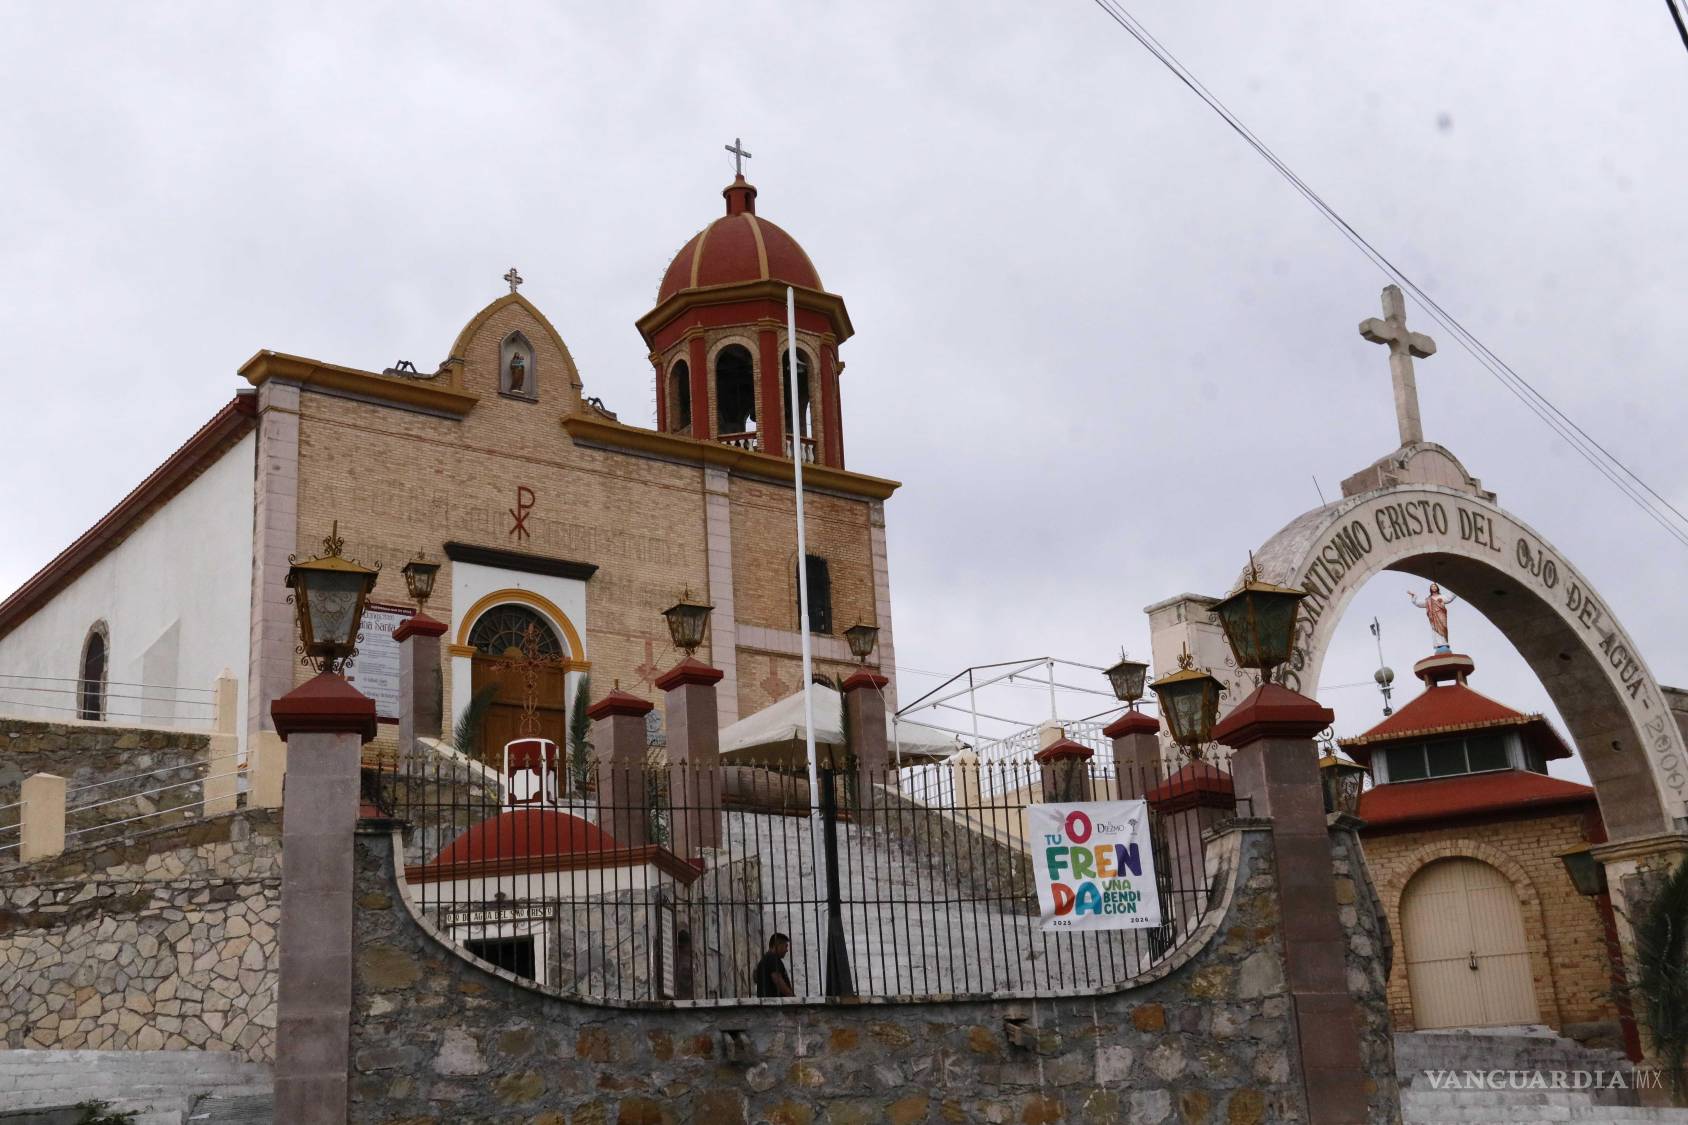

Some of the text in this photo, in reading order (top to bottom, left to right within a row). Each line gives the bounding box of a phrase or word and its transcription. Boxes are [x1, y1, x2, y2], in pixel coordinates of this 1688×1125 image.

[1375, 500, 1448, 543] CRISTO
[1458, 507, 1501, 553] DEL
[1516, 537, 1558, 589] OJO
[1599, 632, 1645, 700] AGUA
[1044, 810, 1092, 846] TU O
[1046, 843, 1142, 881] FREN
[1051, 881, 1103, 916] DA
[1102, 879, 1131, 891] UNA
[1103, 890, 1141, 903] BENDI
